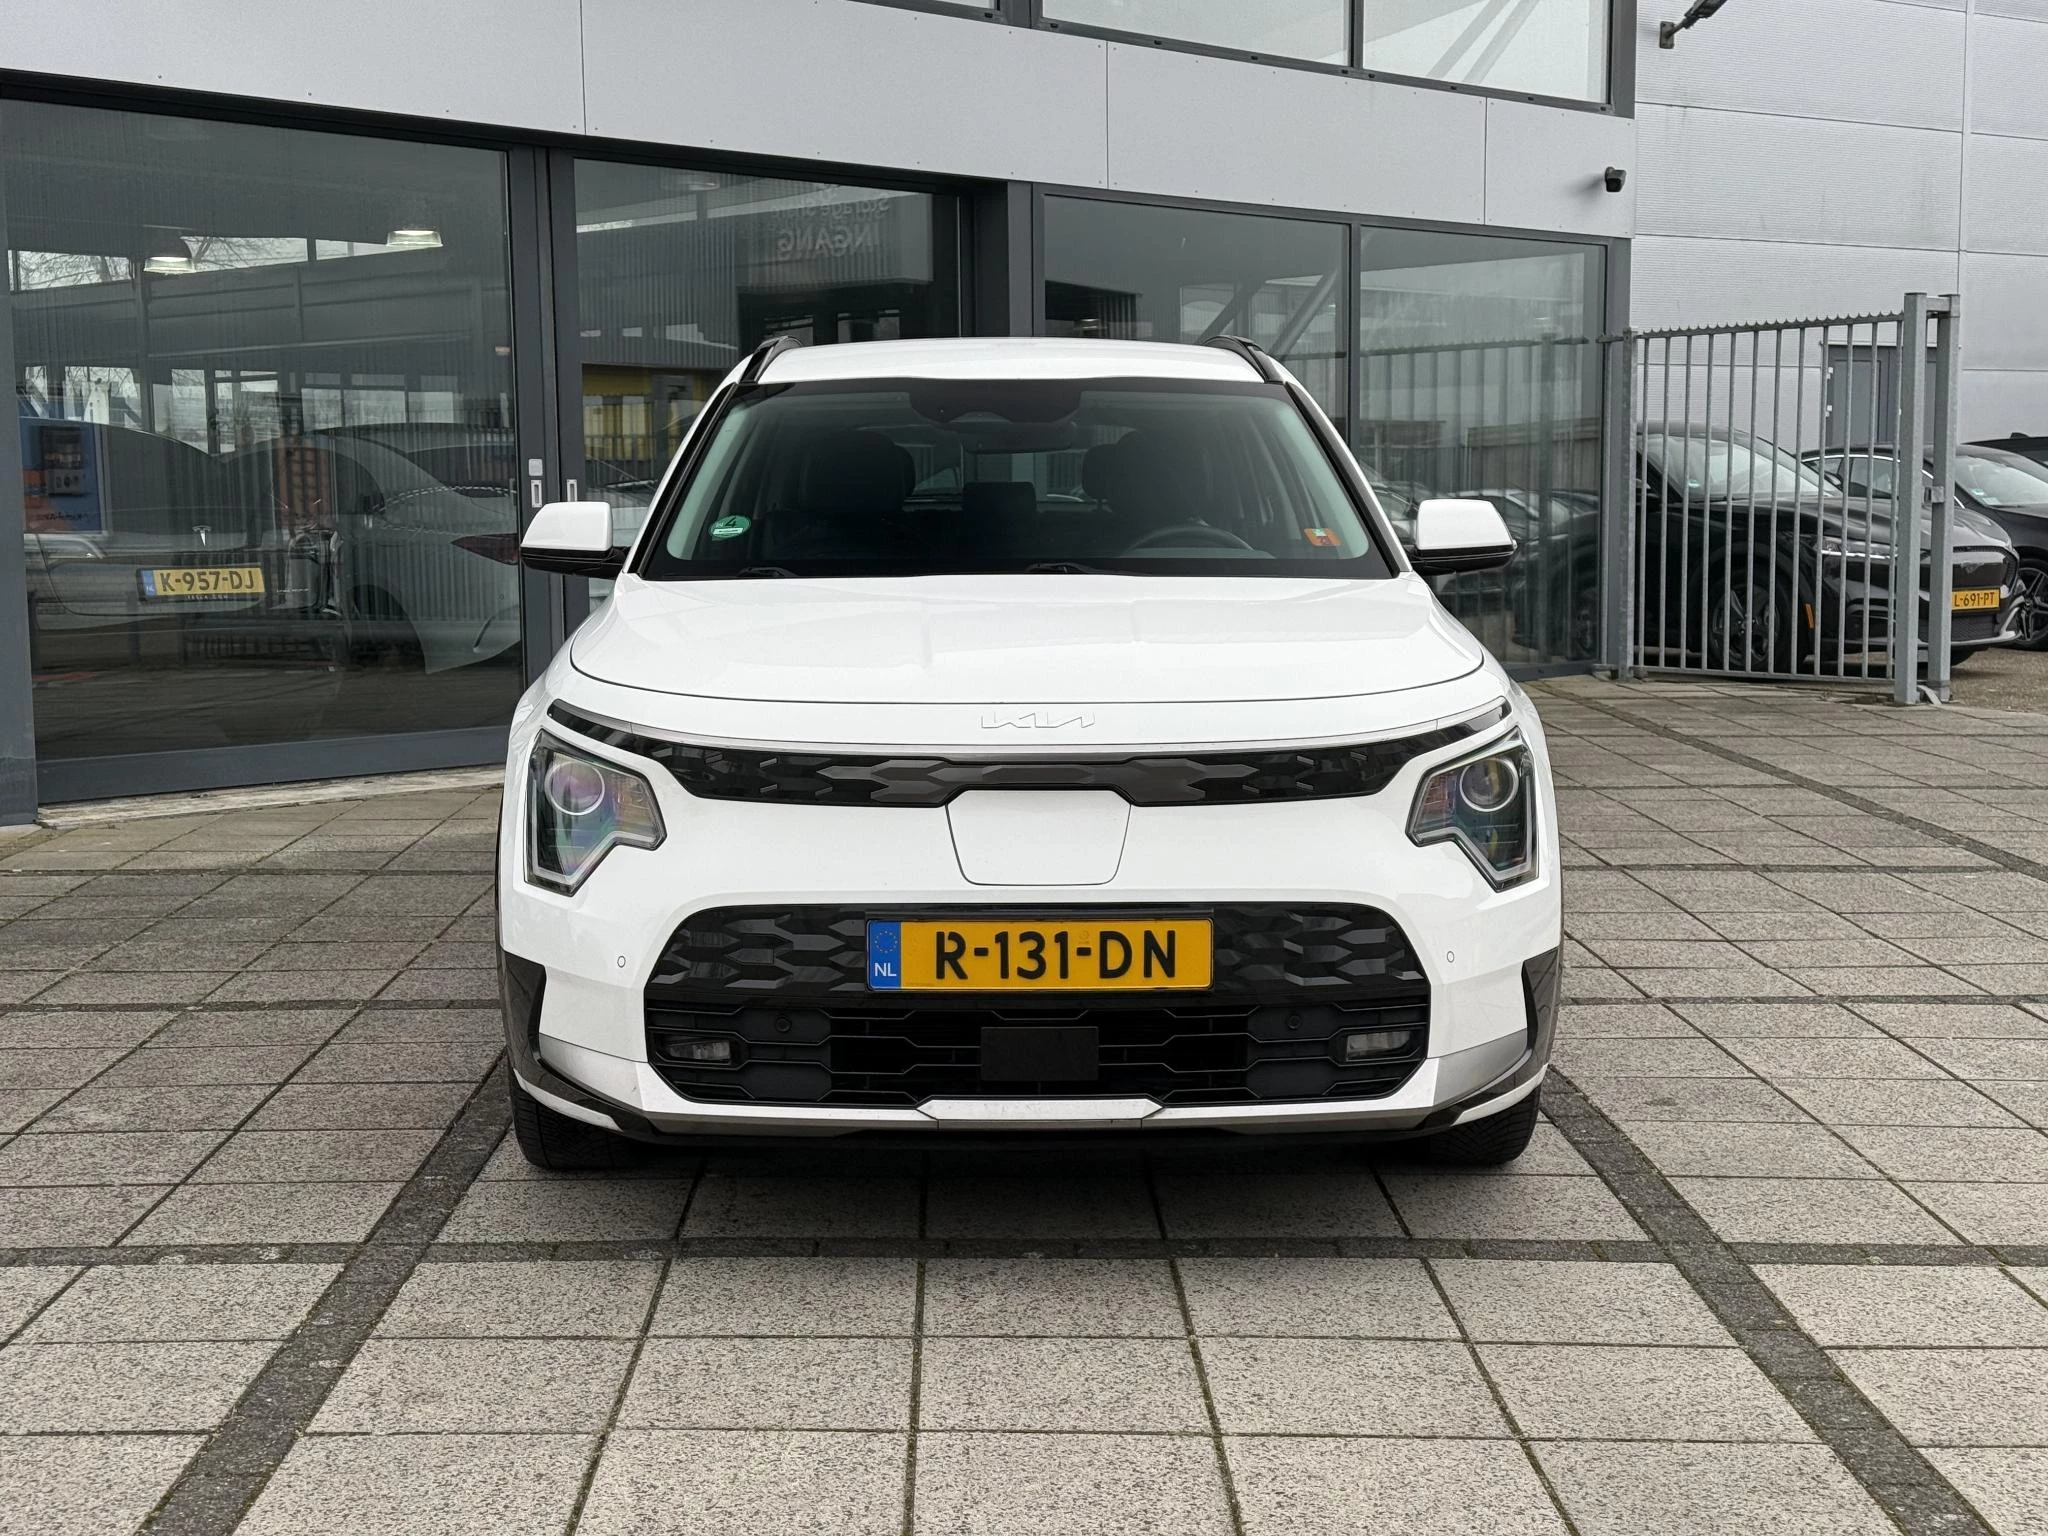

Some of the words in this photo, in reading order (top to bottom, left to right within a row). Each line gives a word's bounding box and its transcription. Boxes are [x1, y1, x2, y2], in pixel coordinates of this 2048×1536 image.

[725, 516, 737, 528] 4
[159, 570, 254, 592] K-957-DJ
[1954, 591, 1995, 607] L-691-PT
[935, 930, 1176, 980] R-131-DN
[874, 963, 897, 977] NL
